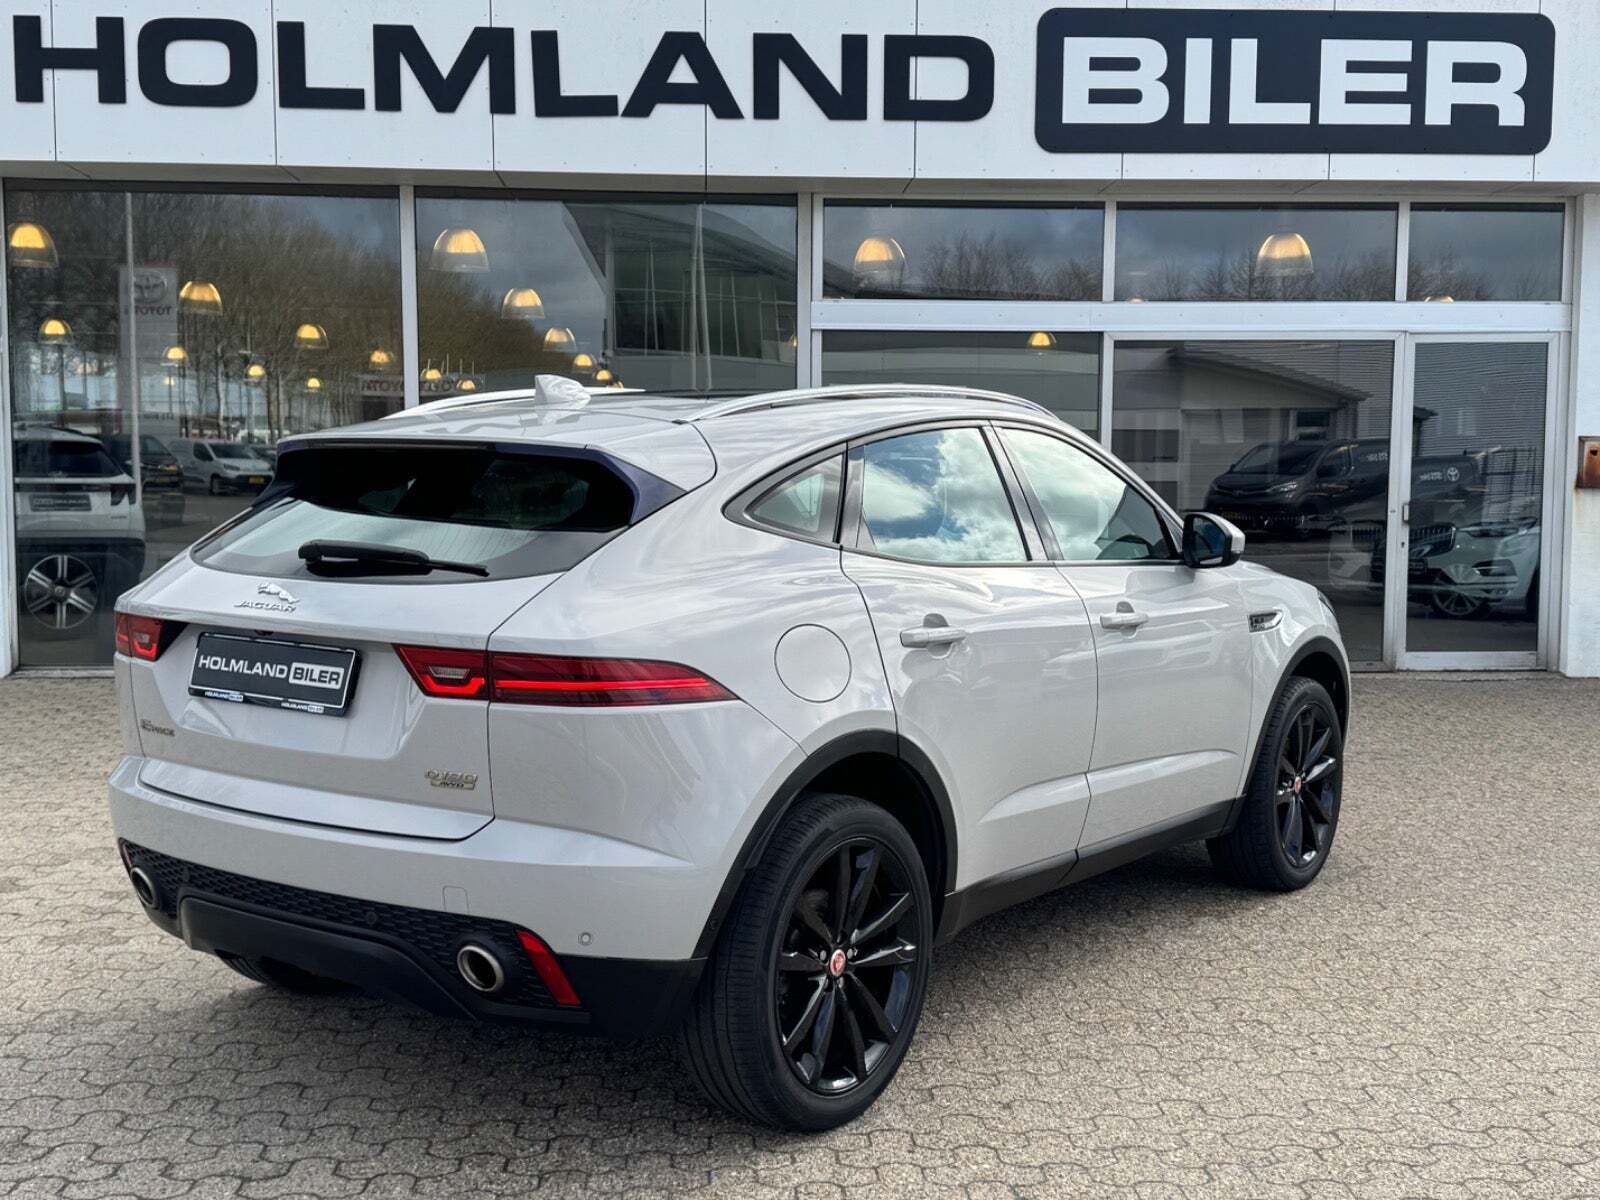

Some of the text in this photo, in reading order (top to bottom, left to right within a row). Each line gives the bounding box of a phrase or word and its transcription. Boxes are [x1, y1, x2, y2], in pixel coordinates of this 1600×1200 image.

[13, 15, 1529, 127] HOLMLAND BILER
[233, 600, 297, 612] JAGUAR
[198, 655, 341, 686] HOLMLAND BILER
[281, 702, 308, 711] HOLMLAND
